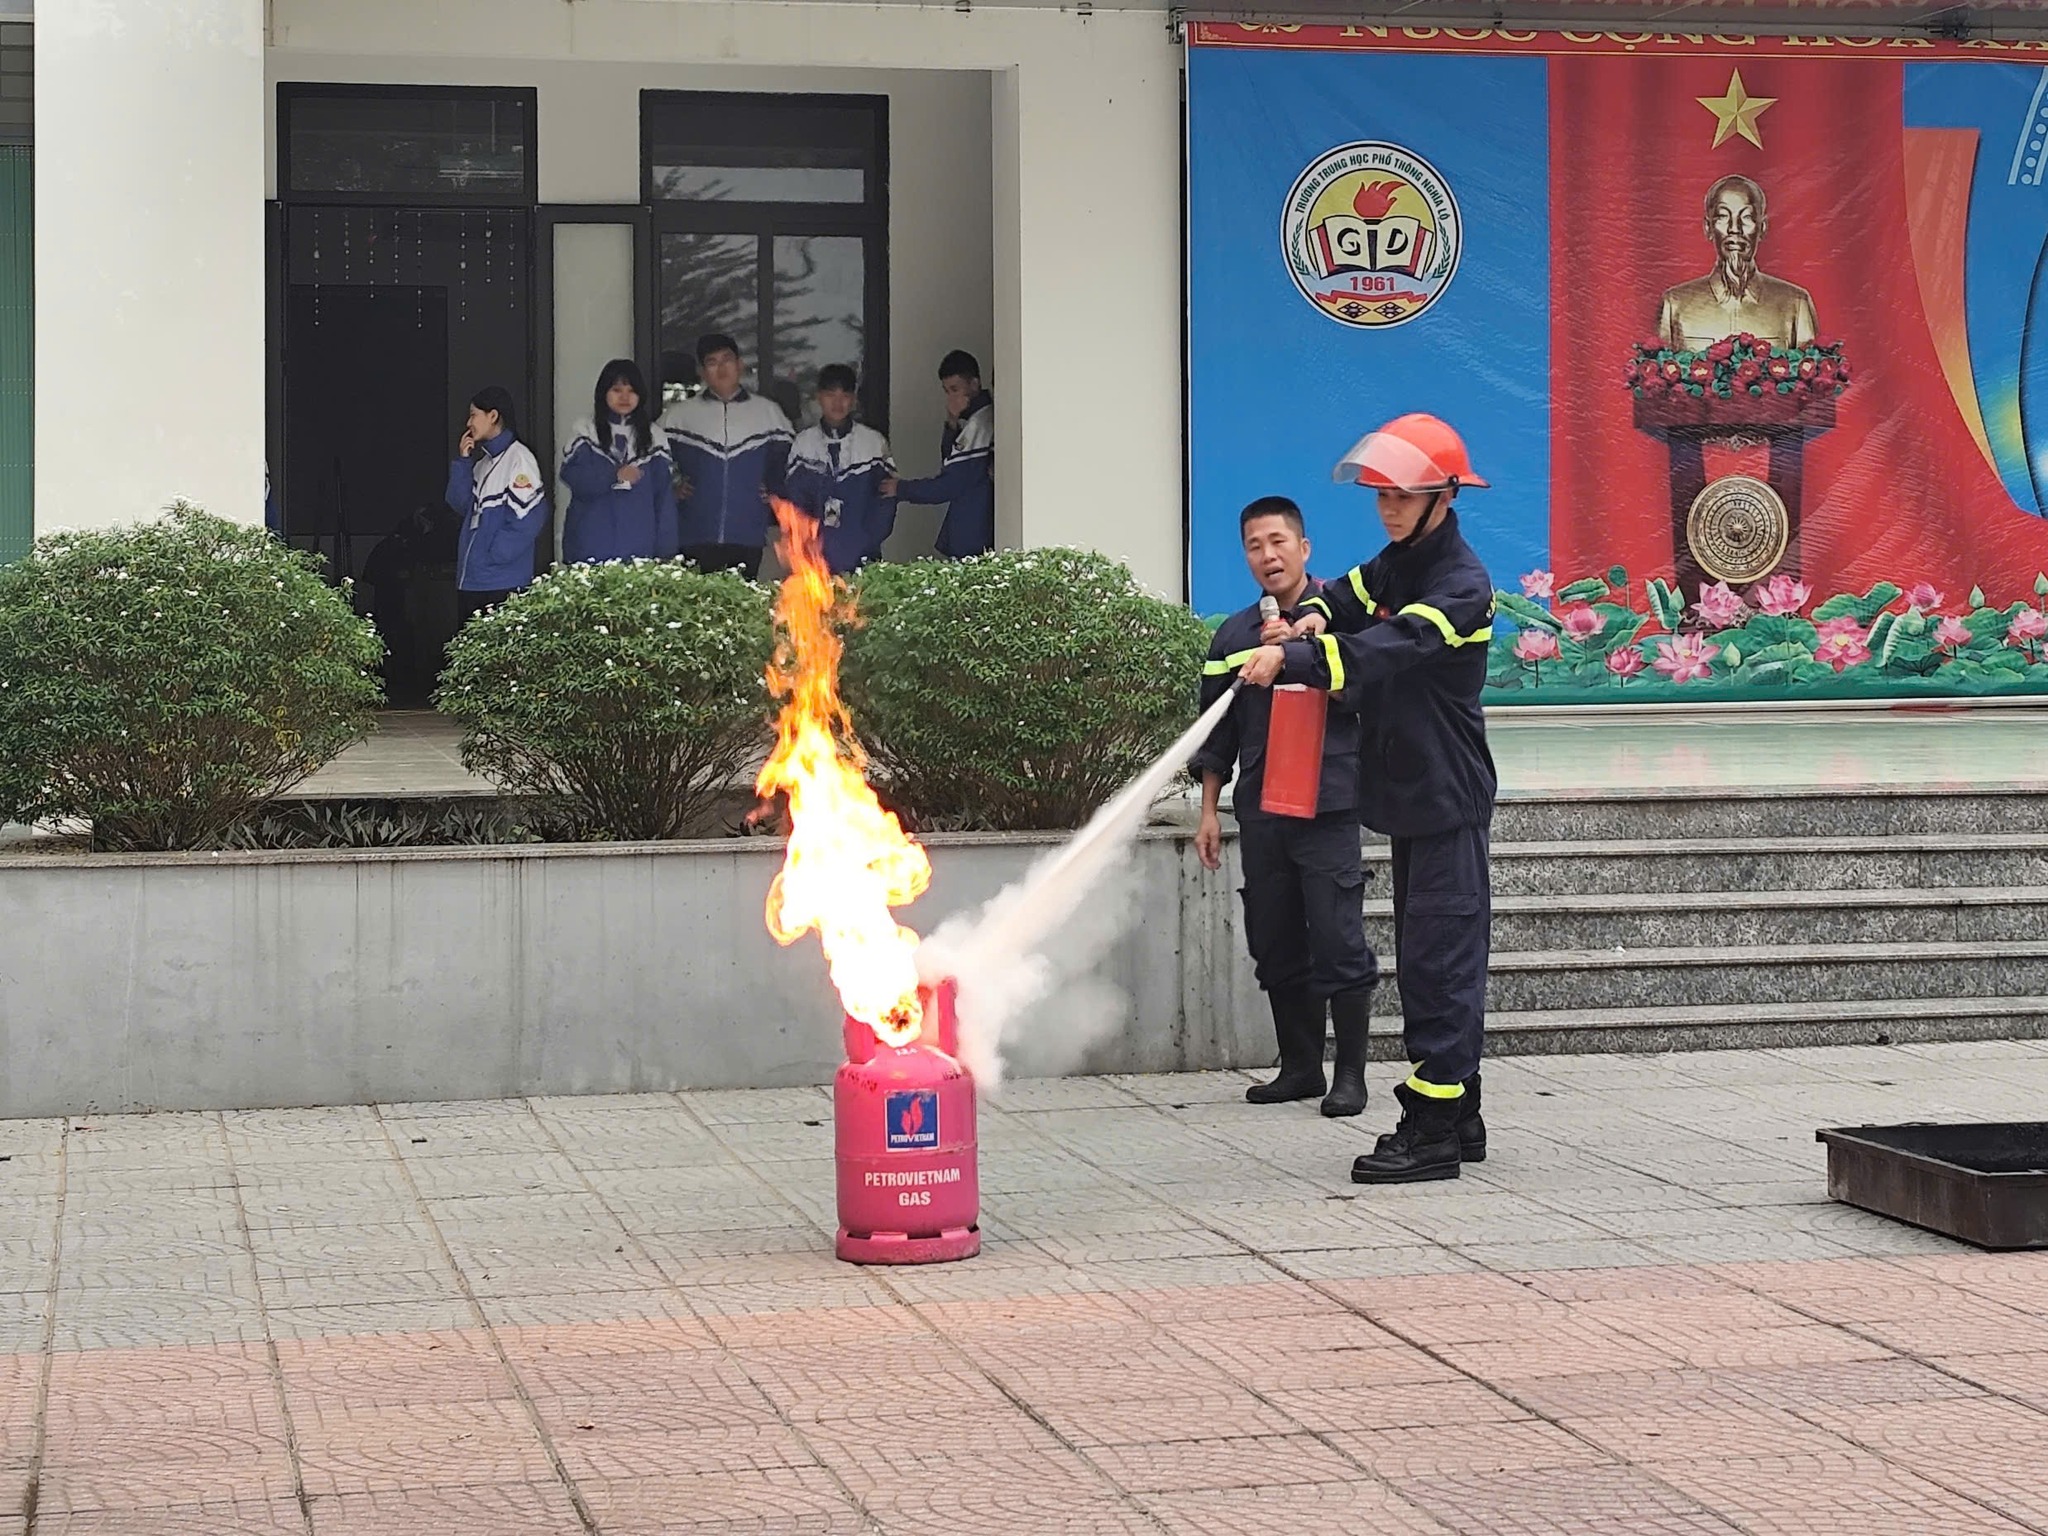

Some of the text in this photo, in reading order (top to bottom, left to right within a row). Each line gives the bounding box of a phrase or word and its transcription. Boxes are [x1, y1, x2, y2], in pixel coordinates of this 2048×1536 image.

[1317, 158, 1348, 182] TRUNG
[1350, 153, 1369, 167] HỌC
[1394, 158, 1423, 182] THÔNG
[1337, 227, 1409, 256] G D
[1350, 276, 1395, 291] 1961
[865, 1168, 961, 1187] PETROVIETNAM
[898, 1191, 931, 1206] GAS
